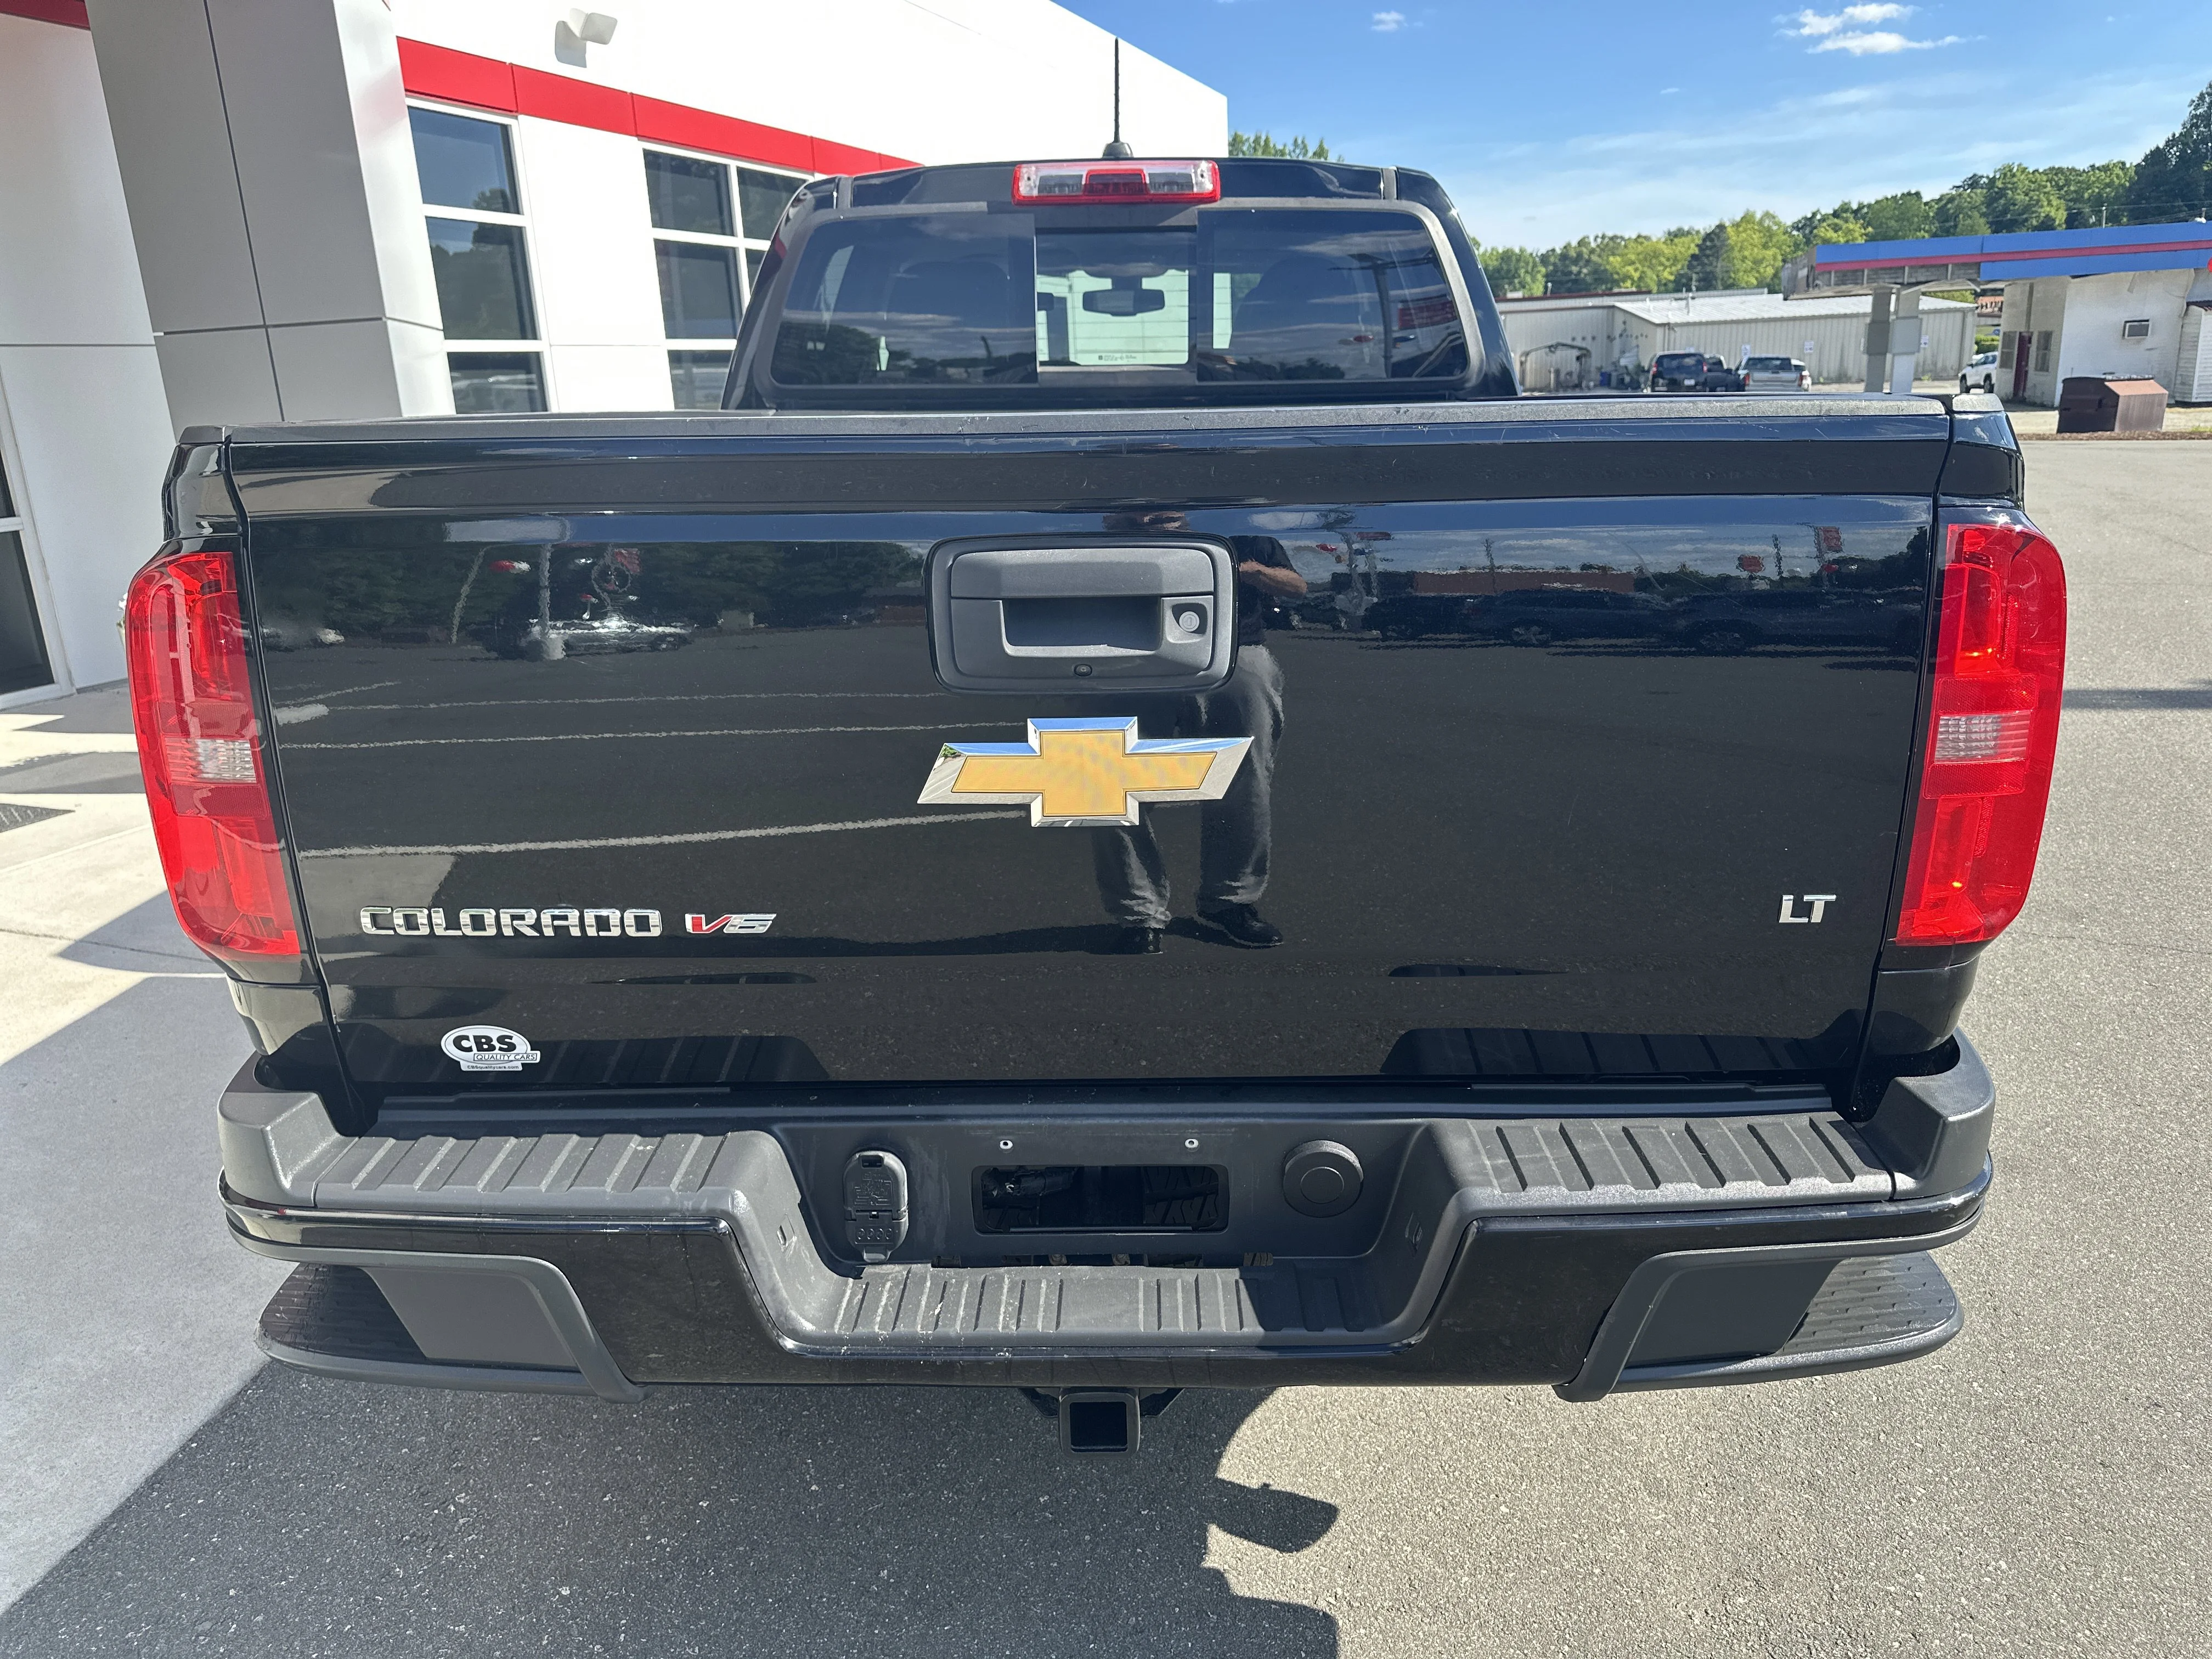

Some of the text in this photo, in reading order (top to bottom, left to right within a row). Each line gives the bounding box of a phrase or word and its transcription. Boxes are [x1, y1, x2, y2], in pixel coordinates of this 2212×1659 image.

[360, 906, 777, 937] COLORADO V6
[1778, 894, 1837, 923] LT
[453, 1034, 517, 1053] CBS
